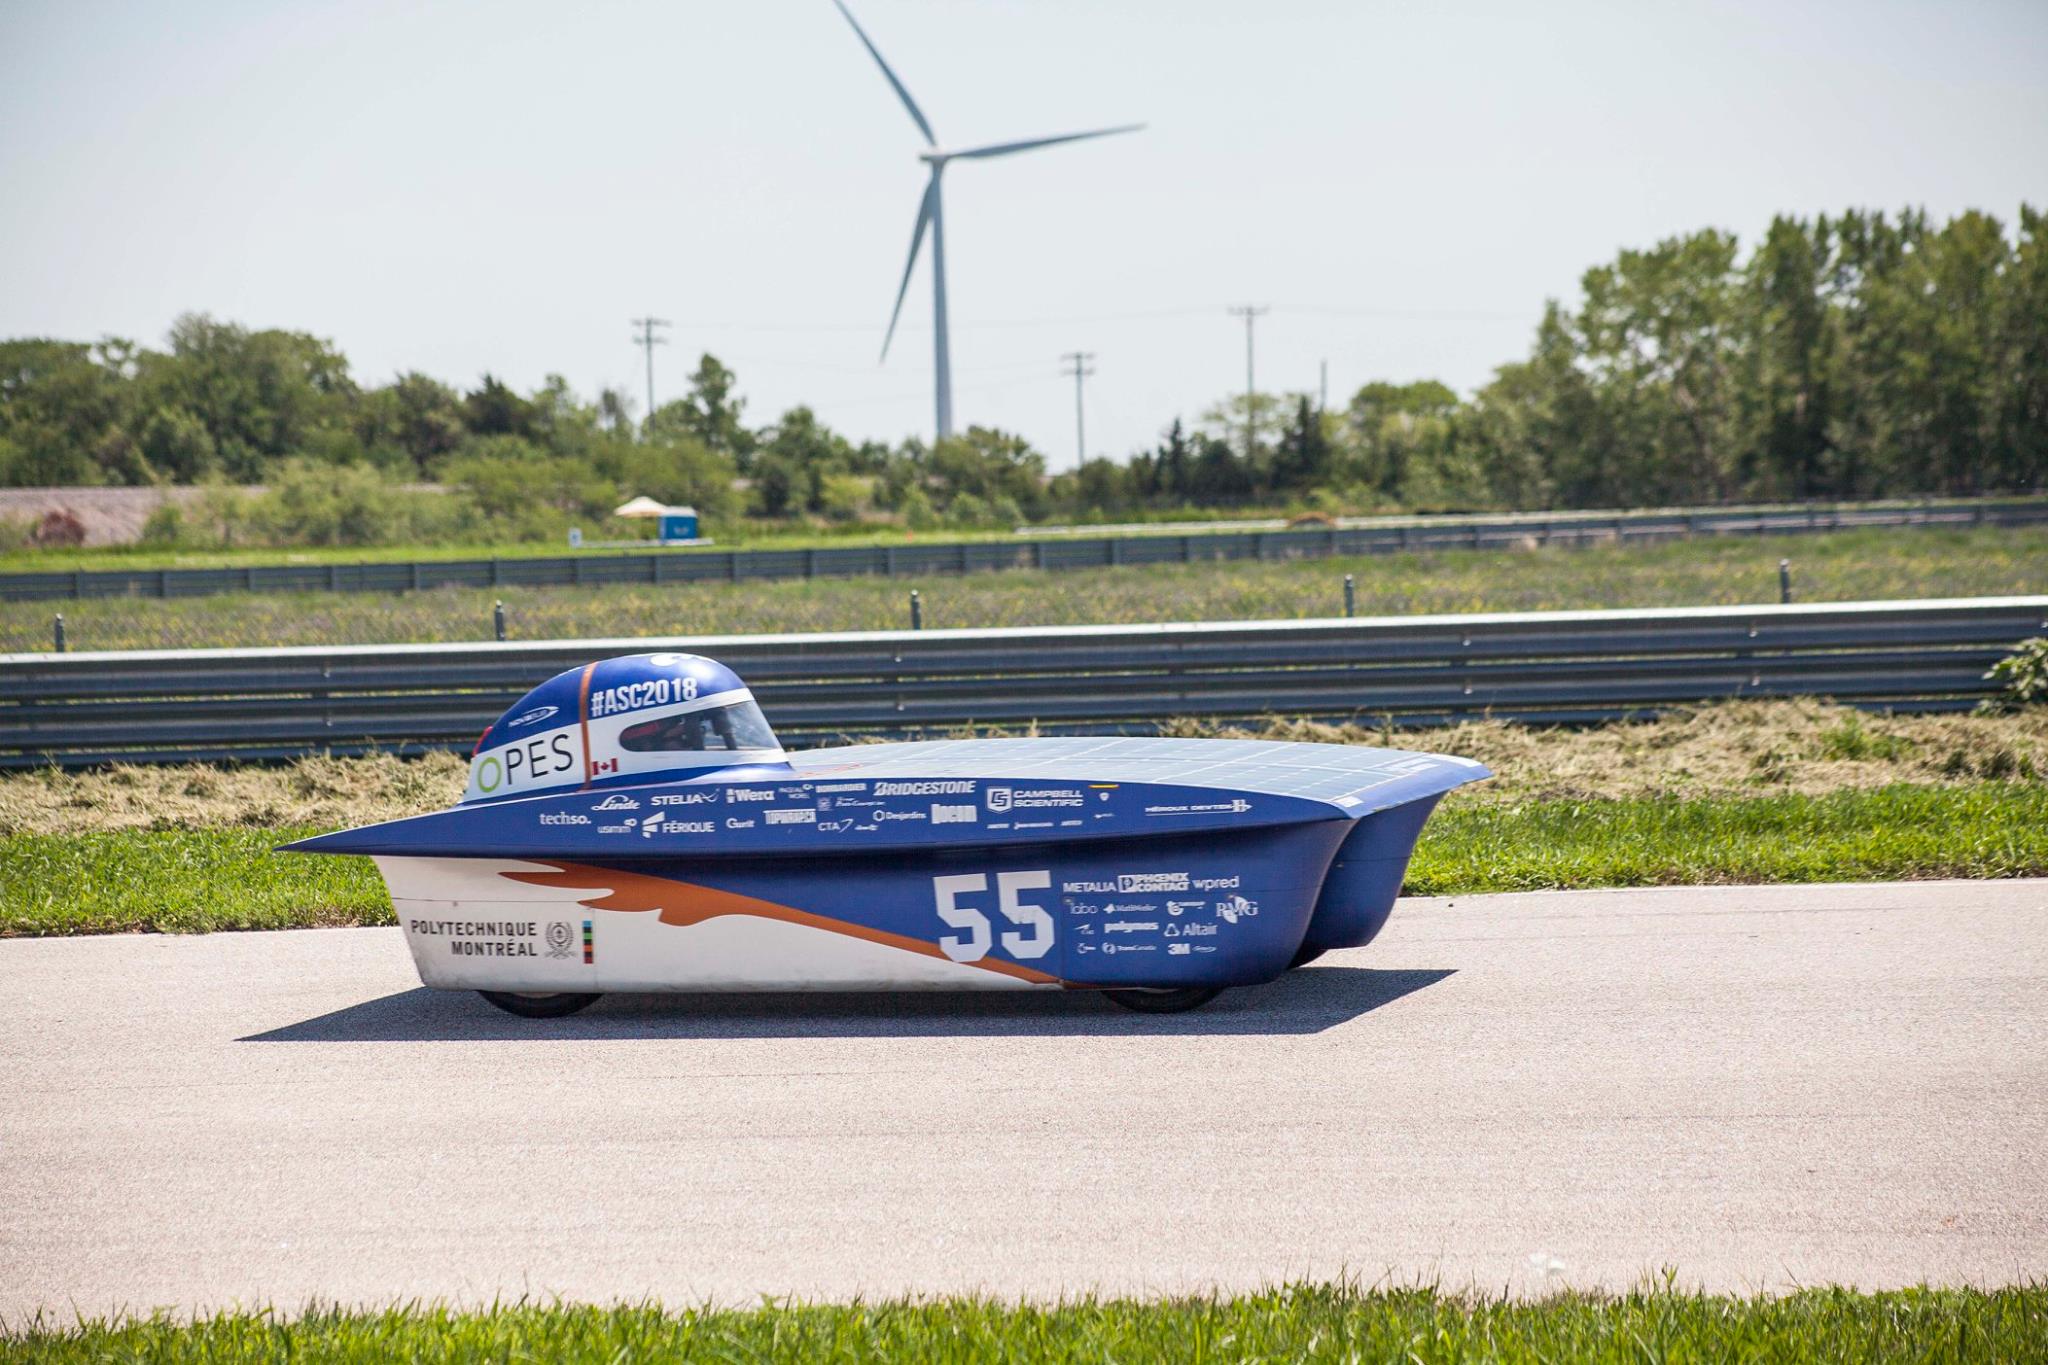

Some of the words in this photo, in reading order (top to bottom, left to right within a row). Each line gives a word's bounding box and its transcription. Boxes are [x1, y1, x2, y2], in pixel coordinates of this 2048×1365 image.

[591, 677, 697, 717] #ASC2018
[477, 733, 573, 793] OPES
[735, 788, 776, 801] Wera
[873, 781, 976, 796] BRIDGESTONE
[1013, 790, 1084, 798] CAMPBELL
[591, 795, 641, 811] Linde
[651, 793, 702, 805] STELIA
[1013, 799, 1084, 807] SCIENTIFIC
[662, 820, 716, 833] FÉRIQUE
[817, 822, 841, 831] CTA
[1063, 882, 1117, 892] METALIA
[1192, 875, 1239, 891] wpred
[933, 870, 1055, 963] 55
[411, 920, 537, 936] POLYTECHNIQUE
[1183, 922, 1218, 936] Altair
[451, 939, 538, 956] MONTRÉAL
[1168, 943, 1190, 955] 3M
